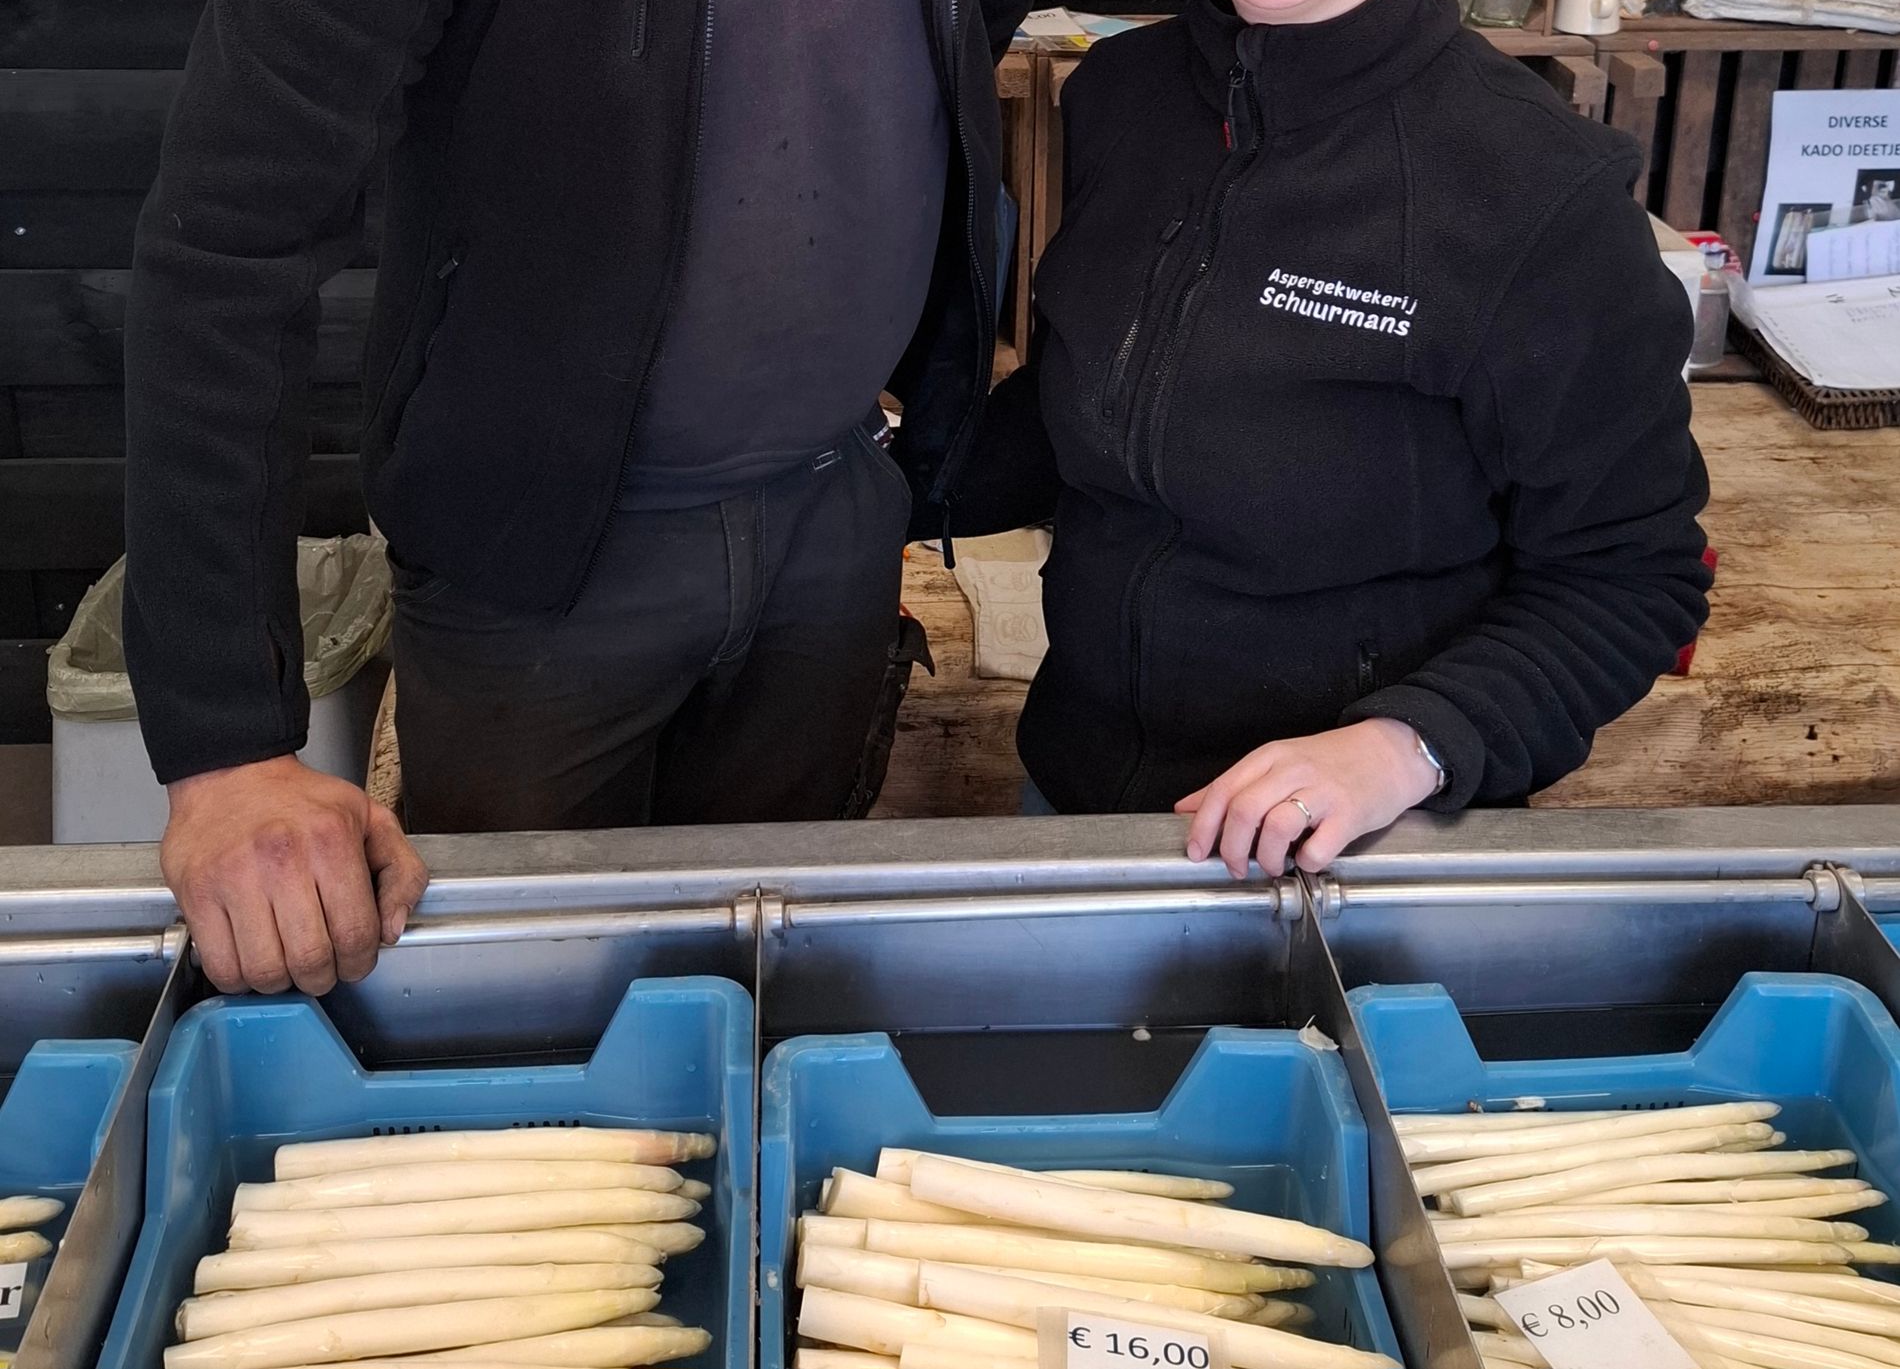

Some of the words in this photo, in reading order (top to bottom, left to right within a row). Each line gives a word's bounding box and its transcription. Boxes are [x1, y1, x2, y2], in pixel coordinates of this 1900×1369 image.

[1828, 115, 1888, 128] DIVERSE
[1801, 144, 1843, 156] KADO
[1259, 286, 1411, 336] Schuurmans
[1268, 268, 1418, 315] Aspergekwekerij
[1521, 1312, 1548, 1338] €
[1548, 1289, 1620, 1330] 8,00
[1068, 1326, 1091, 1349] €
[1105, 1332, 1209, 1369] 16,00
